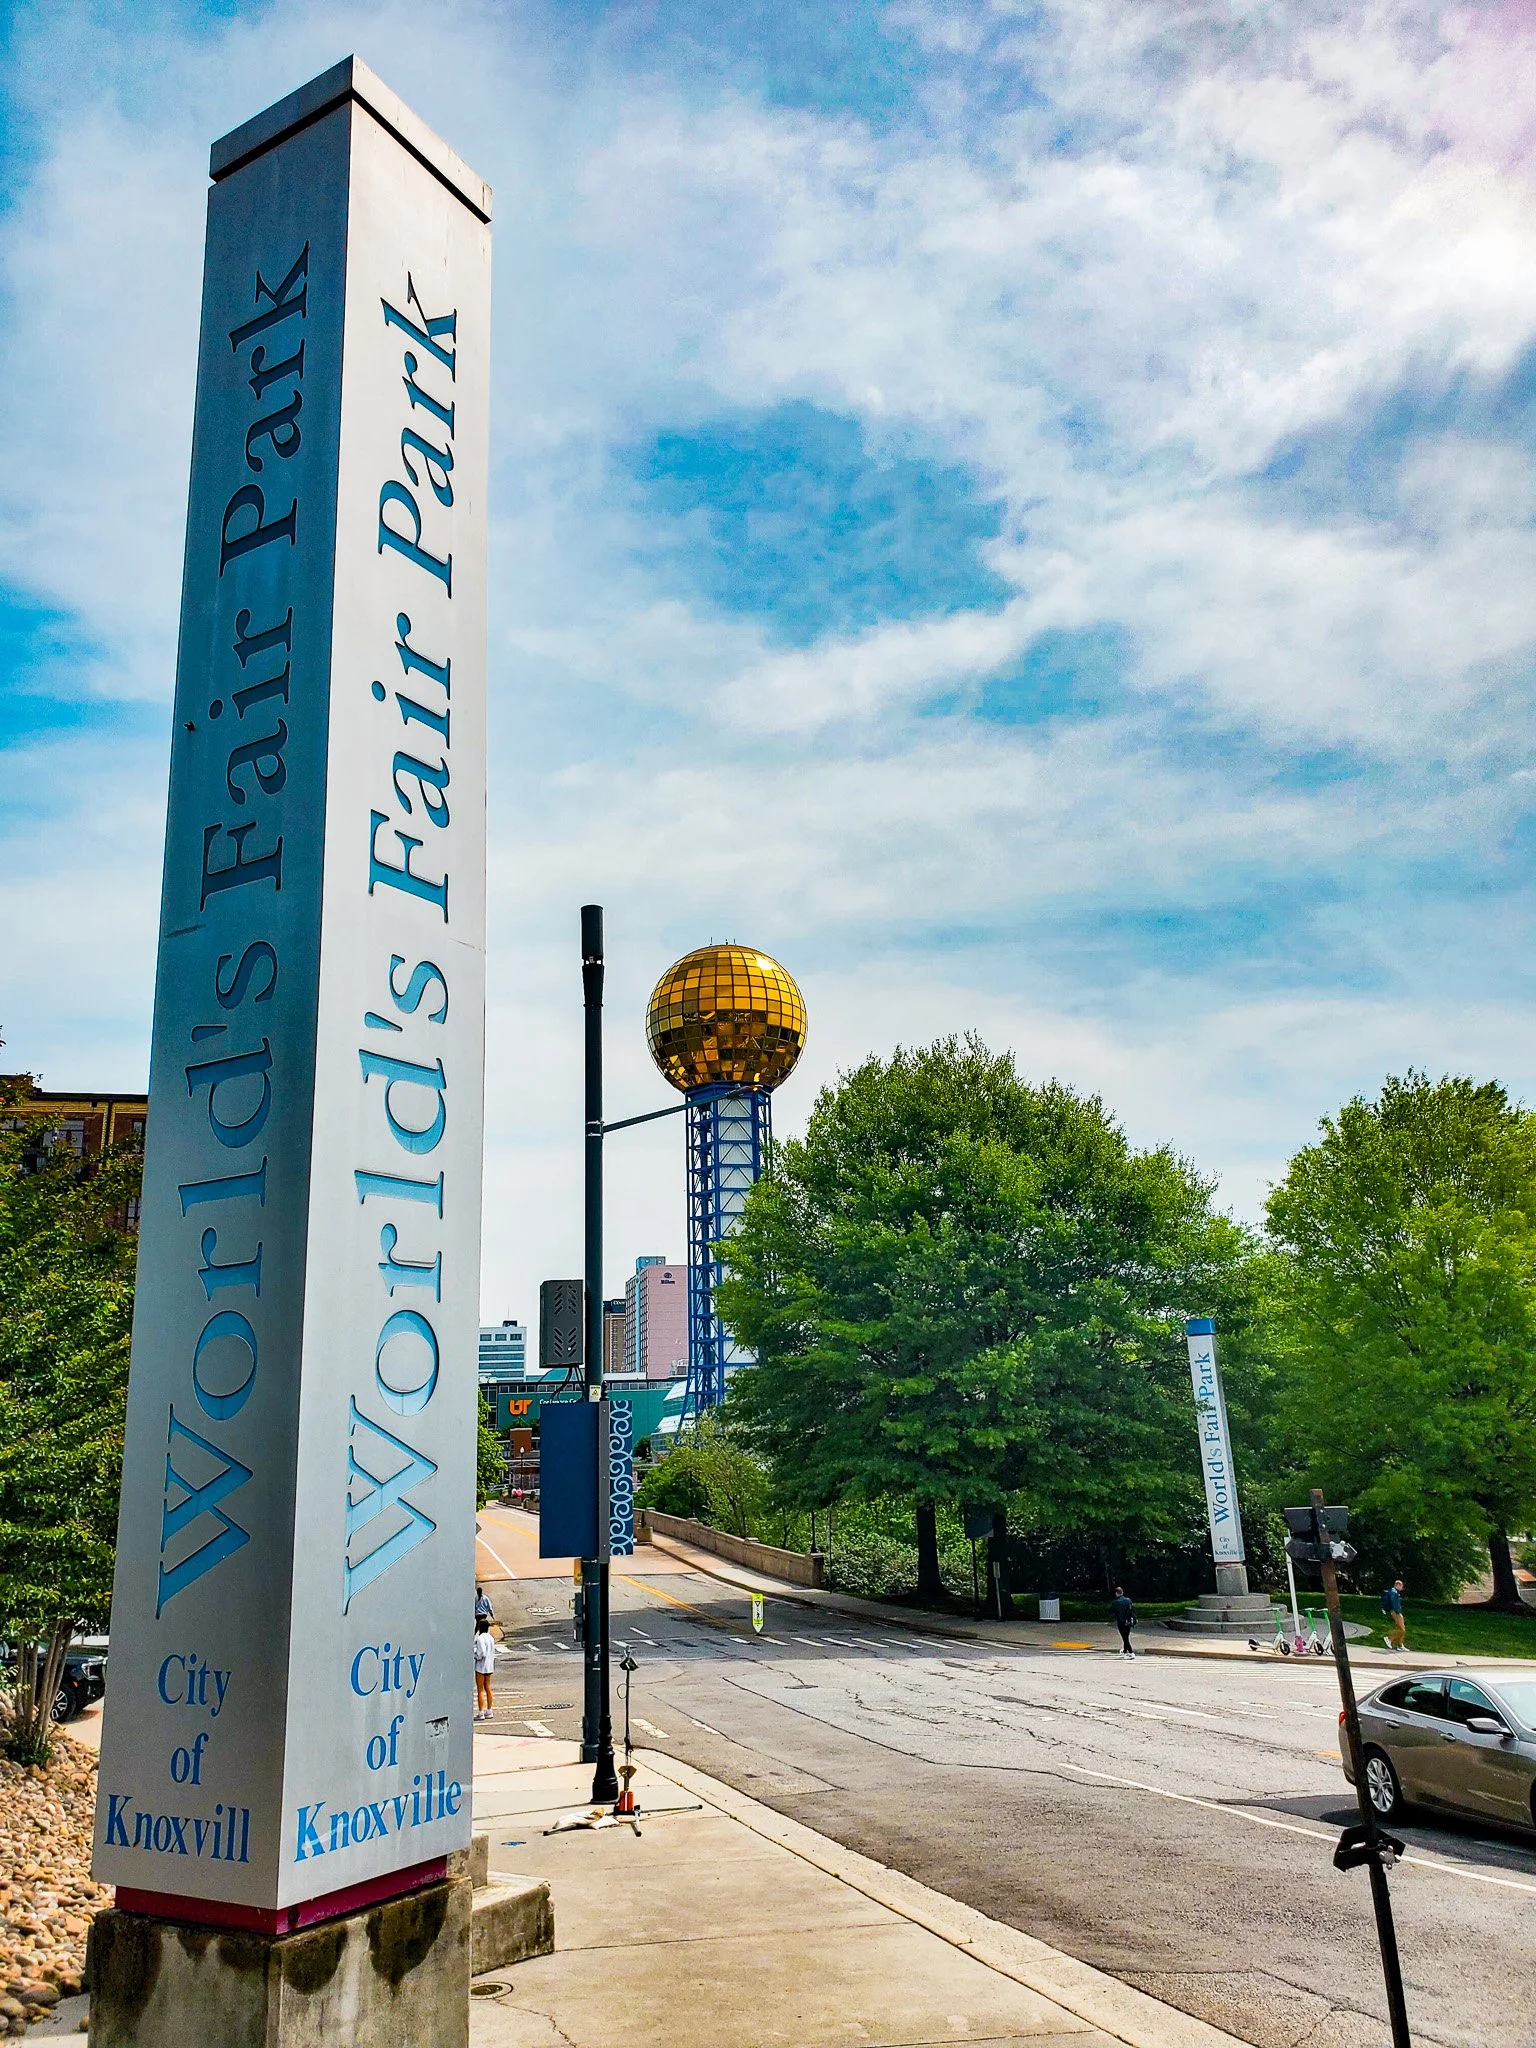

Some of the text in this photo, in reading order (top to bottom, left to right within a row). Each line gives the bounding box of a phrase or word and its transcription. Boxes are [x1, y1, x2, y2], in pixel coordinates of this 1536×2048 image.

[155, 239, 310, 1619] World's Fair Park
[343, 270, 458, 1616] World's Fair Park
[1194, 1351, 1215, 1398] Park
[1207, 1447, 1231, 1526] World's
[158, 1654, 232, 1717] City
[350, 1642, 426, 1698] City
[170, 1733, 209, 1786] of
[366, 1715, 405, 1771] of
[104, 1794, 251, 1863] Knoxvill
[294, 1769, 462, 1863] Knoxville
